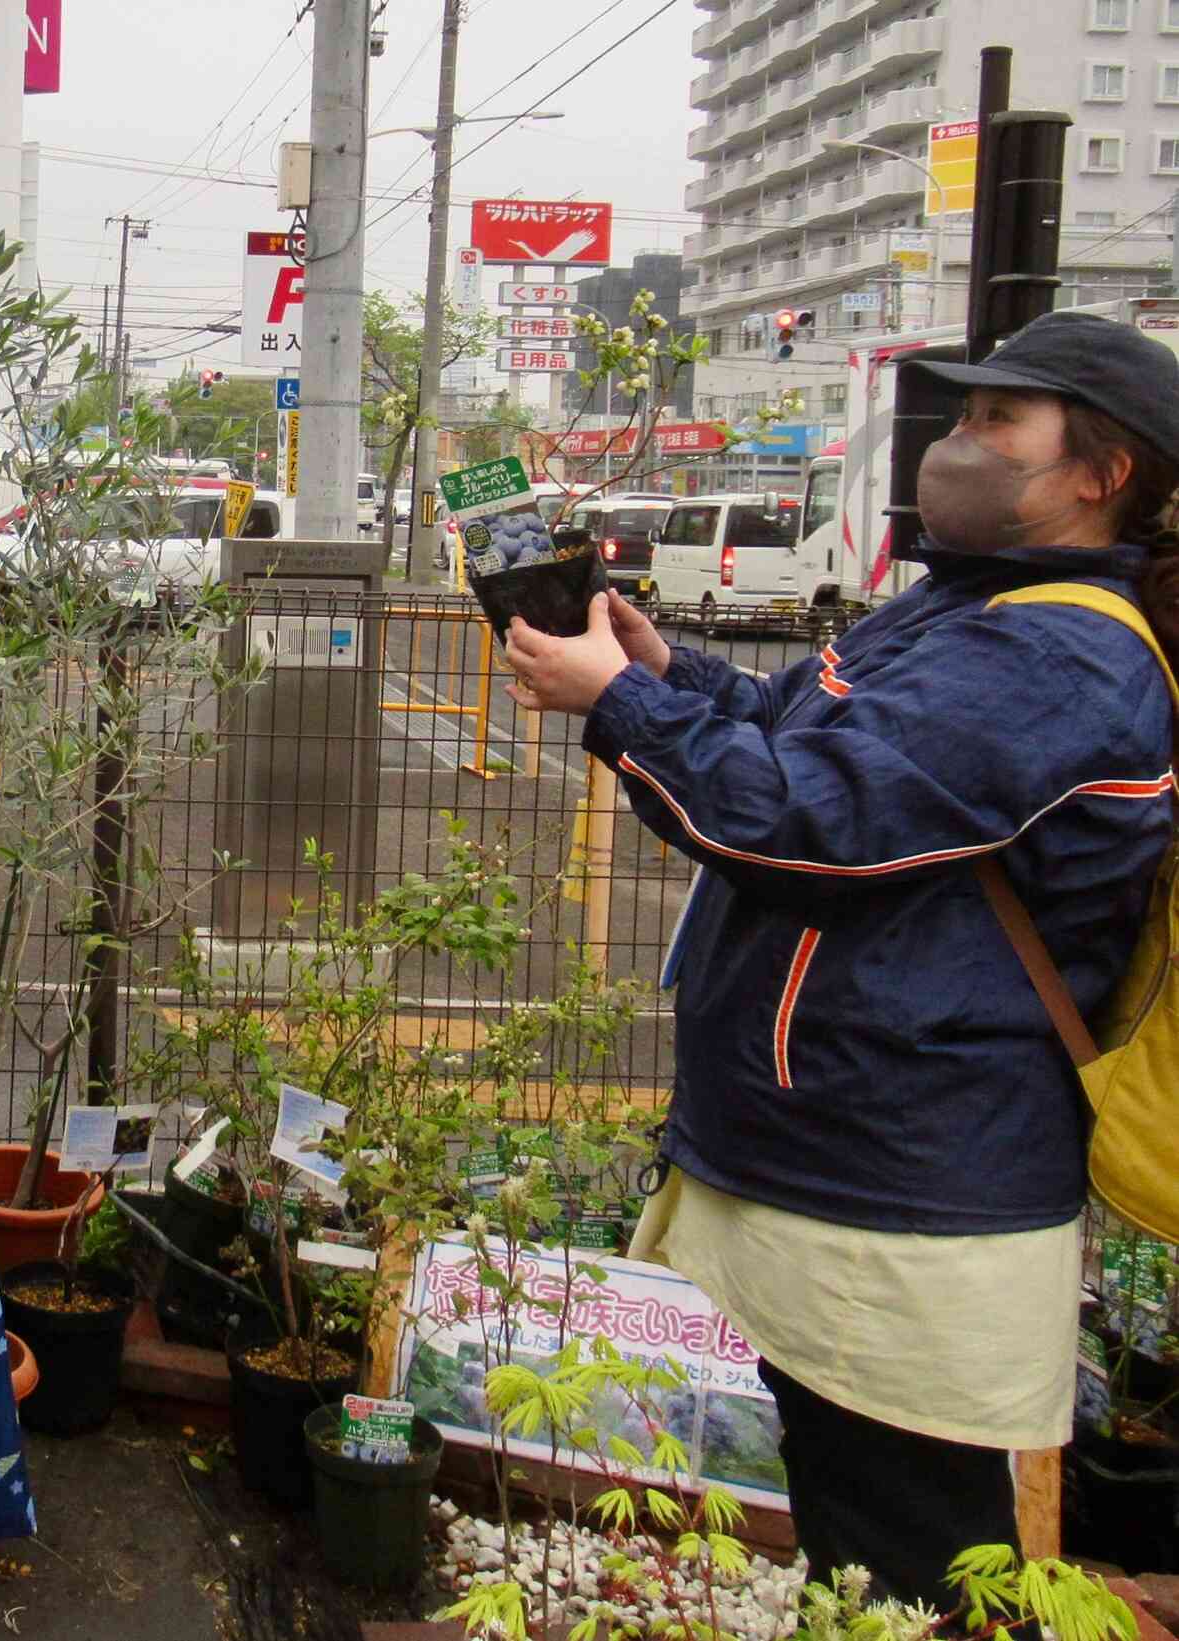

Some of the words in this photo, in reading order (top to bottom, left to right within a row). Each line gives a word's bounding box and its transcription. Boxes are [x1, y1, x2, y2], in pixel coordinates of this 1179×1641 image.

[486, 203, 603, 223] ツルハドラッグ
[513, 286, 568, 303] くすり
[511, 319, 569, 336] 化粧品
[511, 352, 567, 368] 日用品
[460, 472, 521, 496] ブルーベリー
